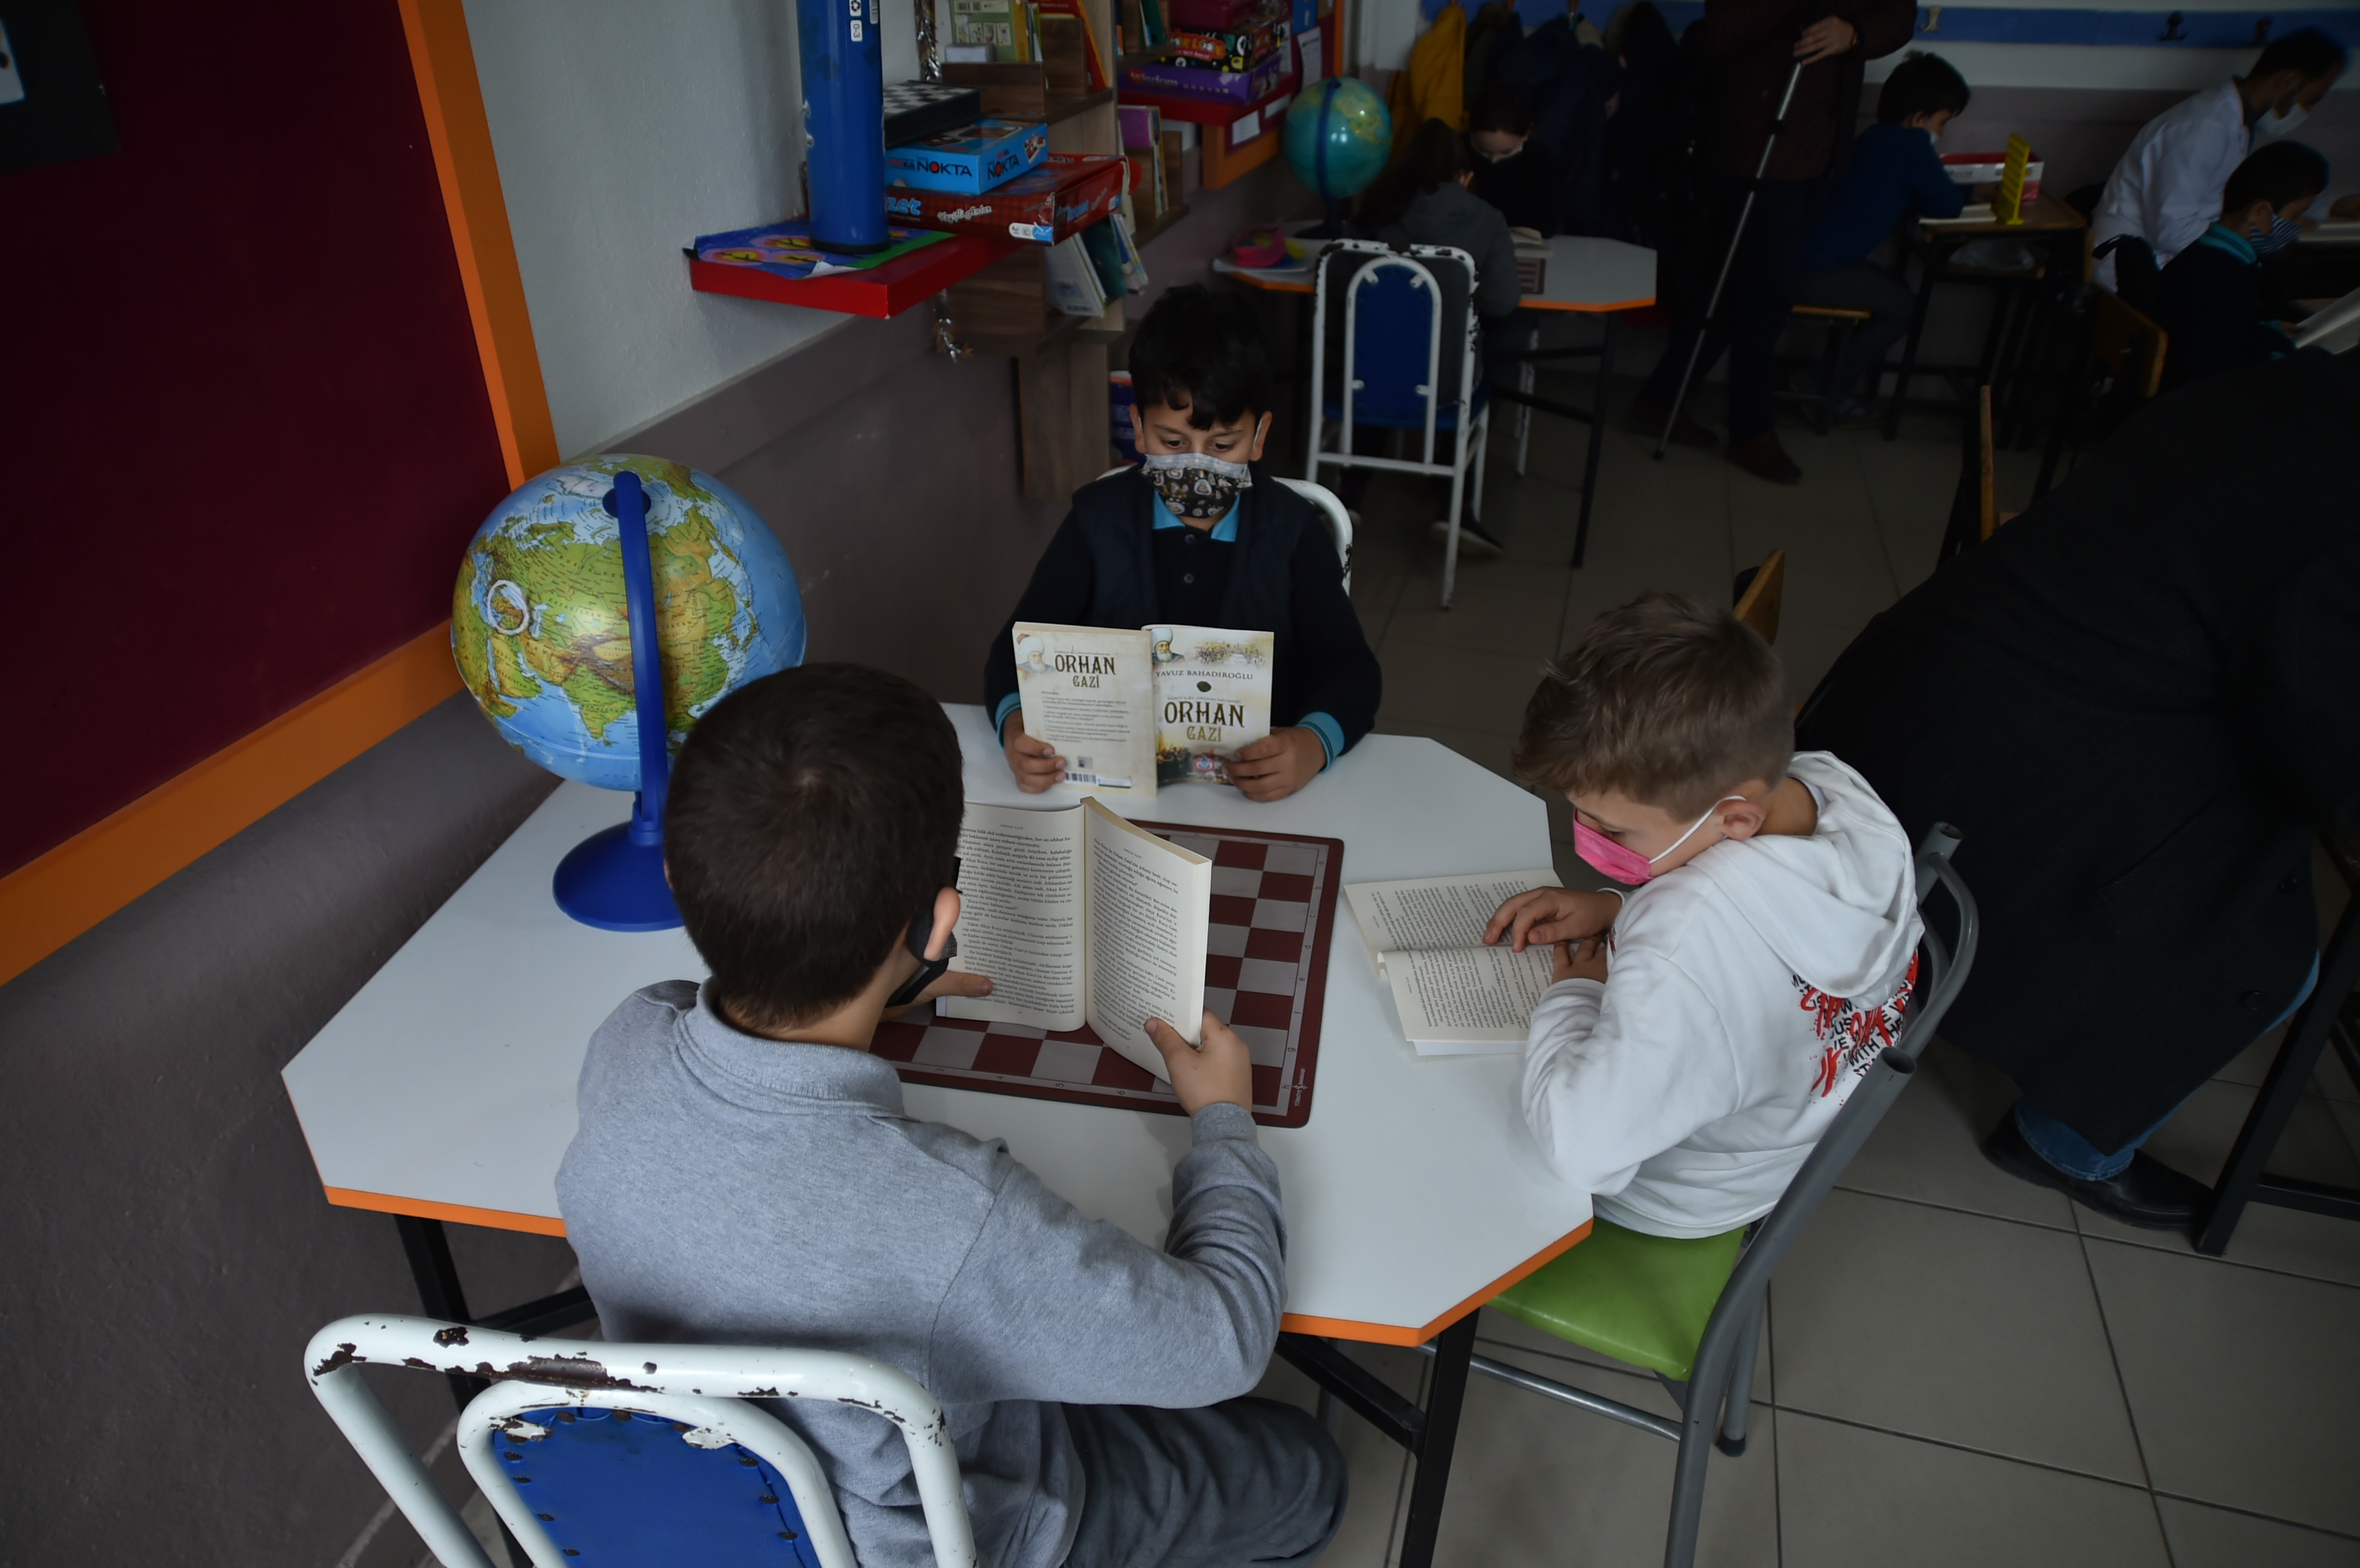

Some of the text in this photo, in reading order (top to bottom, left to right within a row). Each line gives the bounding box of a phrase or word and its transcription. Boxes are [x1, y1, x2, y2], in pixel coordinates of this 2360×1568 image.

[917, 158, 972, 177] NOKTA
[987, 155, 1020, 181] NOKTA
[1055, 654, 1116, 675] ORHAN
[1073, 675, 1100, 688] GAZİ
[1187, 670, 1253, 680] BAHADIROĞLU
[1164, 701, 1244, 728] ORHAN
[1186, 725, 1222, 743] GAZİ
